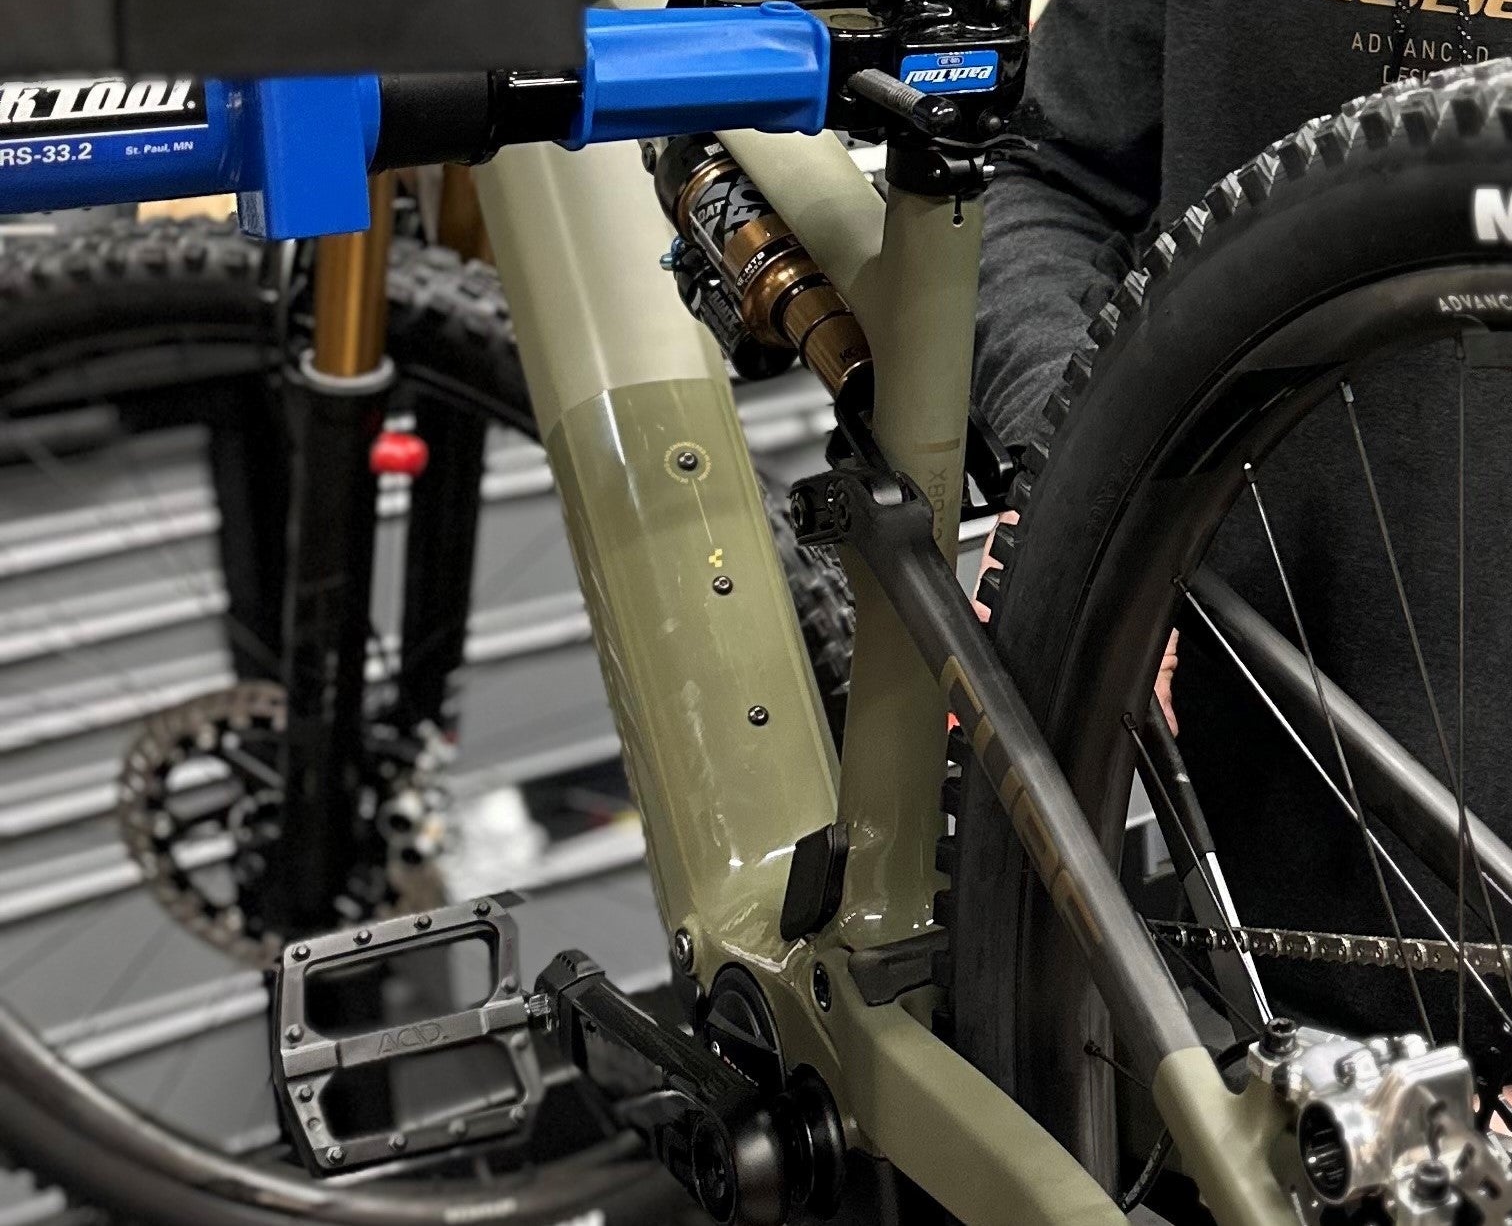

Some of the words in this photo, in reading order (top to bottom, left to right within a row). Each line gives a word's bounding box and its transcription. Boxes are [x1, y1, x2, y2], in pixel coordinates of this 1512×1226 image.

[1351, 31, 1489, 63] ADANCD
[125, 145, 141, 156] St.
[173, 140, 194, 152] MN
